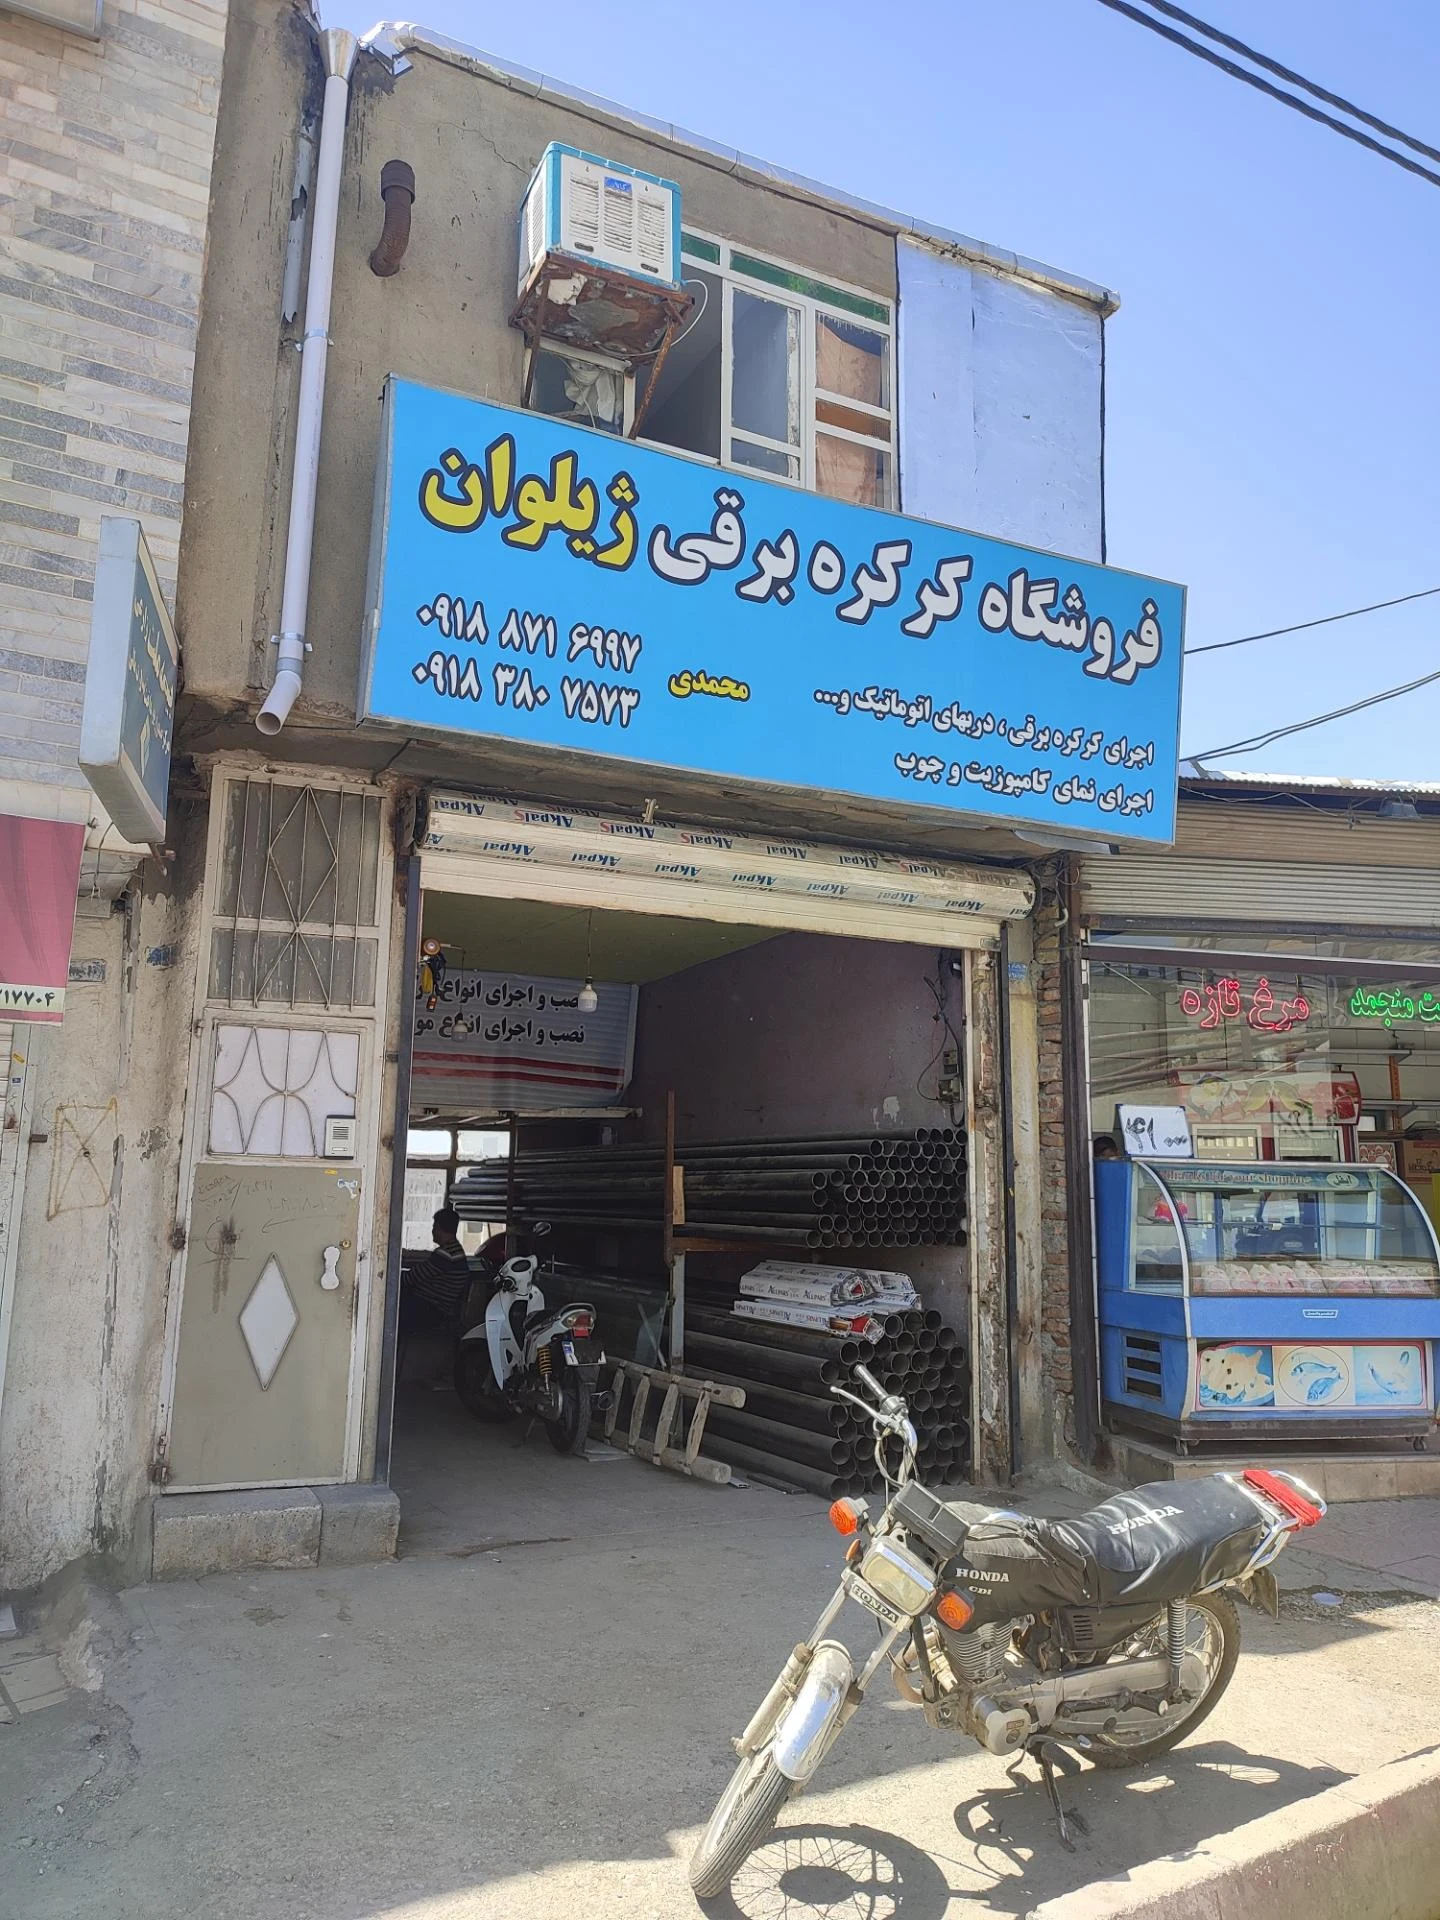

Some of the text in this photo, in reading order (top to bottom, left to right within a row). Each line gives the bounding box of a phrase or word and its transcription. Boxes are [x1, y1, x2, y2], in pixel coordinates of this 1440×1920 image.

[419, 432, 639, 571] ژیلوان
[648, 486, 799, 606] برقی
[416, 593, 642, 673] ۰۹۱۸ ۸۷۱ ۶۹۹۷
[978, 566, 1162, 685] فروشگاه
[412, 650, 639, 728] ۰۹۱۸ ۳۸۰ ۷۵۷۳
[668, 669, 750, 702] محمدی
[853, 685, 932, 727] اتوماتیک
[933, 701, 995, 739] دربهای
[1104, 735, 1154, 770] اجرای
[894, 752, 1154, 817] اجرای نمای کامپوزیت و چوب
[485, 983, 534, 1008] اجرای
[550, 993, 579, 1012] صب
[1182, 977, 1310, 1031] مرغ تازه
[1351, 987, 1414, 1027] منجمد
[484, 1016, 532, 1042] اجرای
[549, 1025, 585, 1046] نصب
[1105, 1505, 1184, 1535] HONDA
[955, 1567, 1010, 1583] HONDA
[968, 1585, 993, 1596] CDI
[852, 1585, 899, 1623] HONDA
